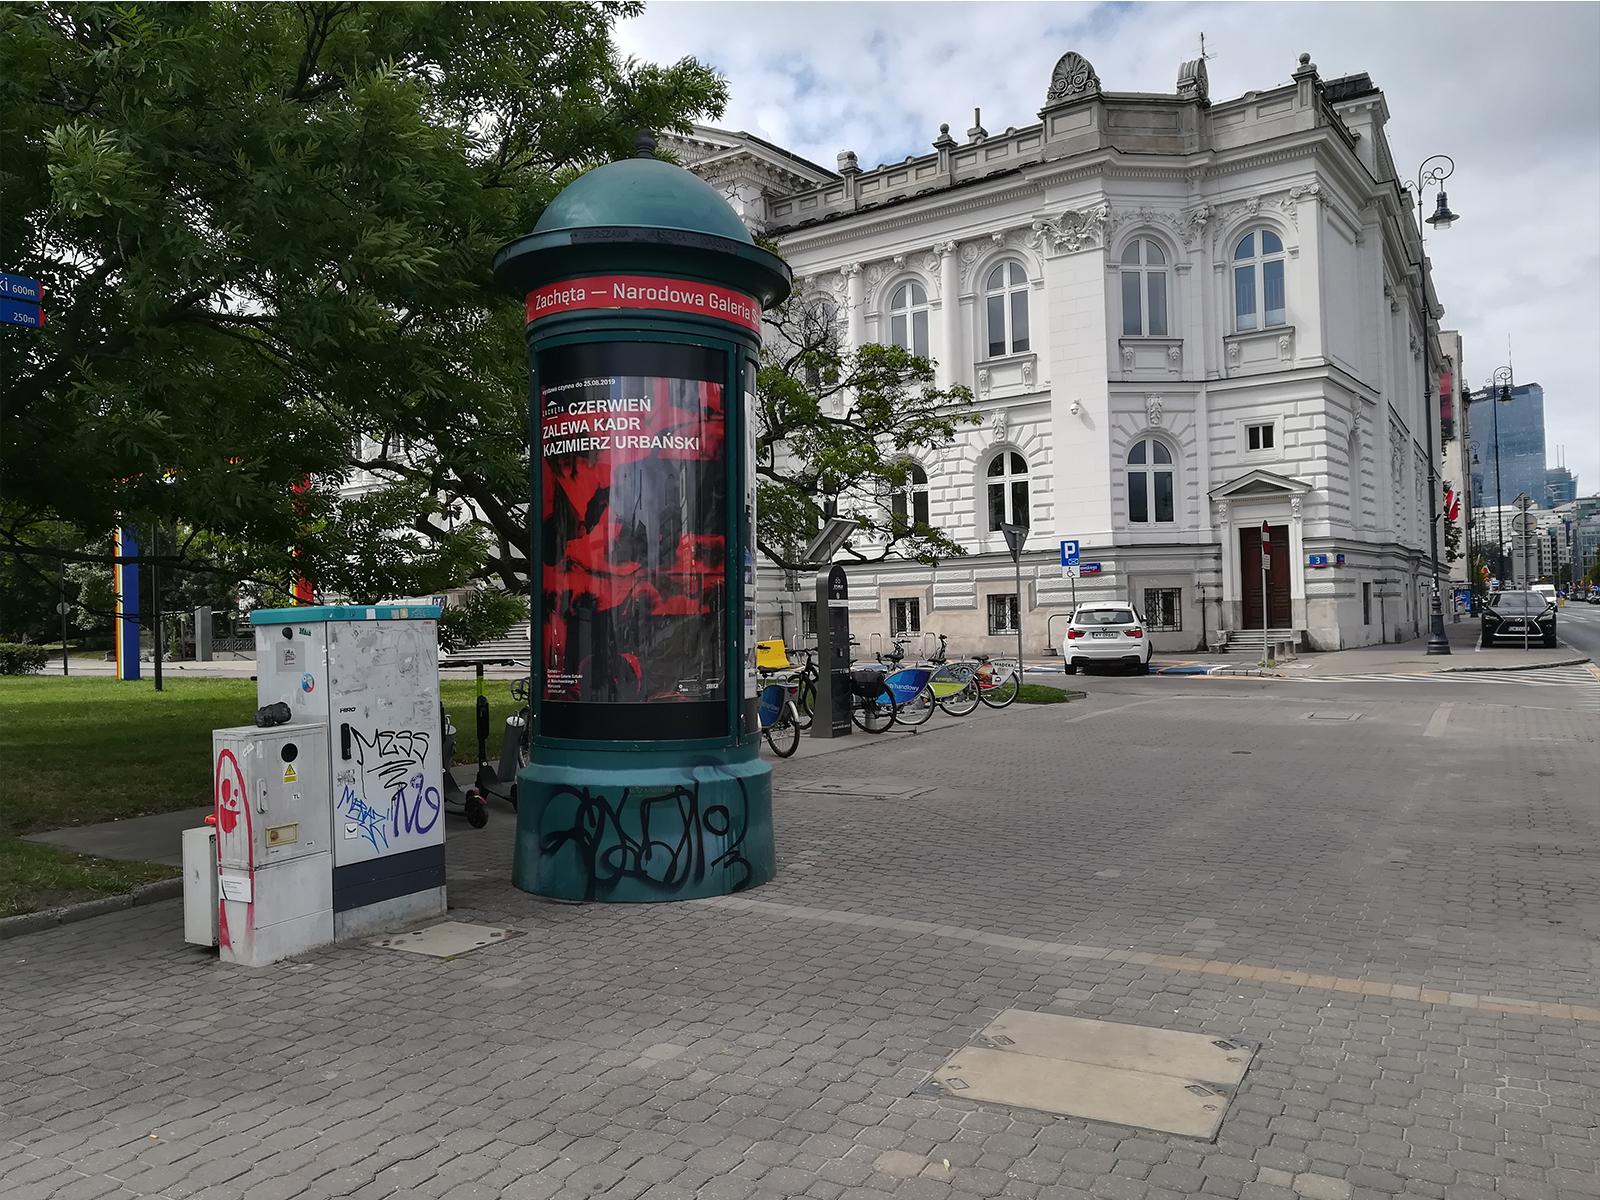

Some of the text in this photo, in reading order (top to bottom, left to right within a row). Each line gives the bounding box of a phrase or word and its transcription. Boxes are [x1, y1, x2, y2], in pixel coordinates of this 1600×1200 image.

[12, 284, 35, 297] 600m
[535, 287, 586, 311] Zachęta
[613, 282, 705, 307] Narodowa
[709, 292, 751, 321] Galeria
[13, 312, 36, 325] 250m
[557, 383, 575, 392] czynna
[583, 378, 616, 388] 25.08.2019
[568, 395, 651, 416] CZERWIEŃ
[542, 417, 641, 440] ZALEWA KADR
[543, 432, 699, 457] KAZIMIERZ URBAŃSKI
[1064, 542, 1076, 559] P
[1315, 556, 1321, 565] 3
